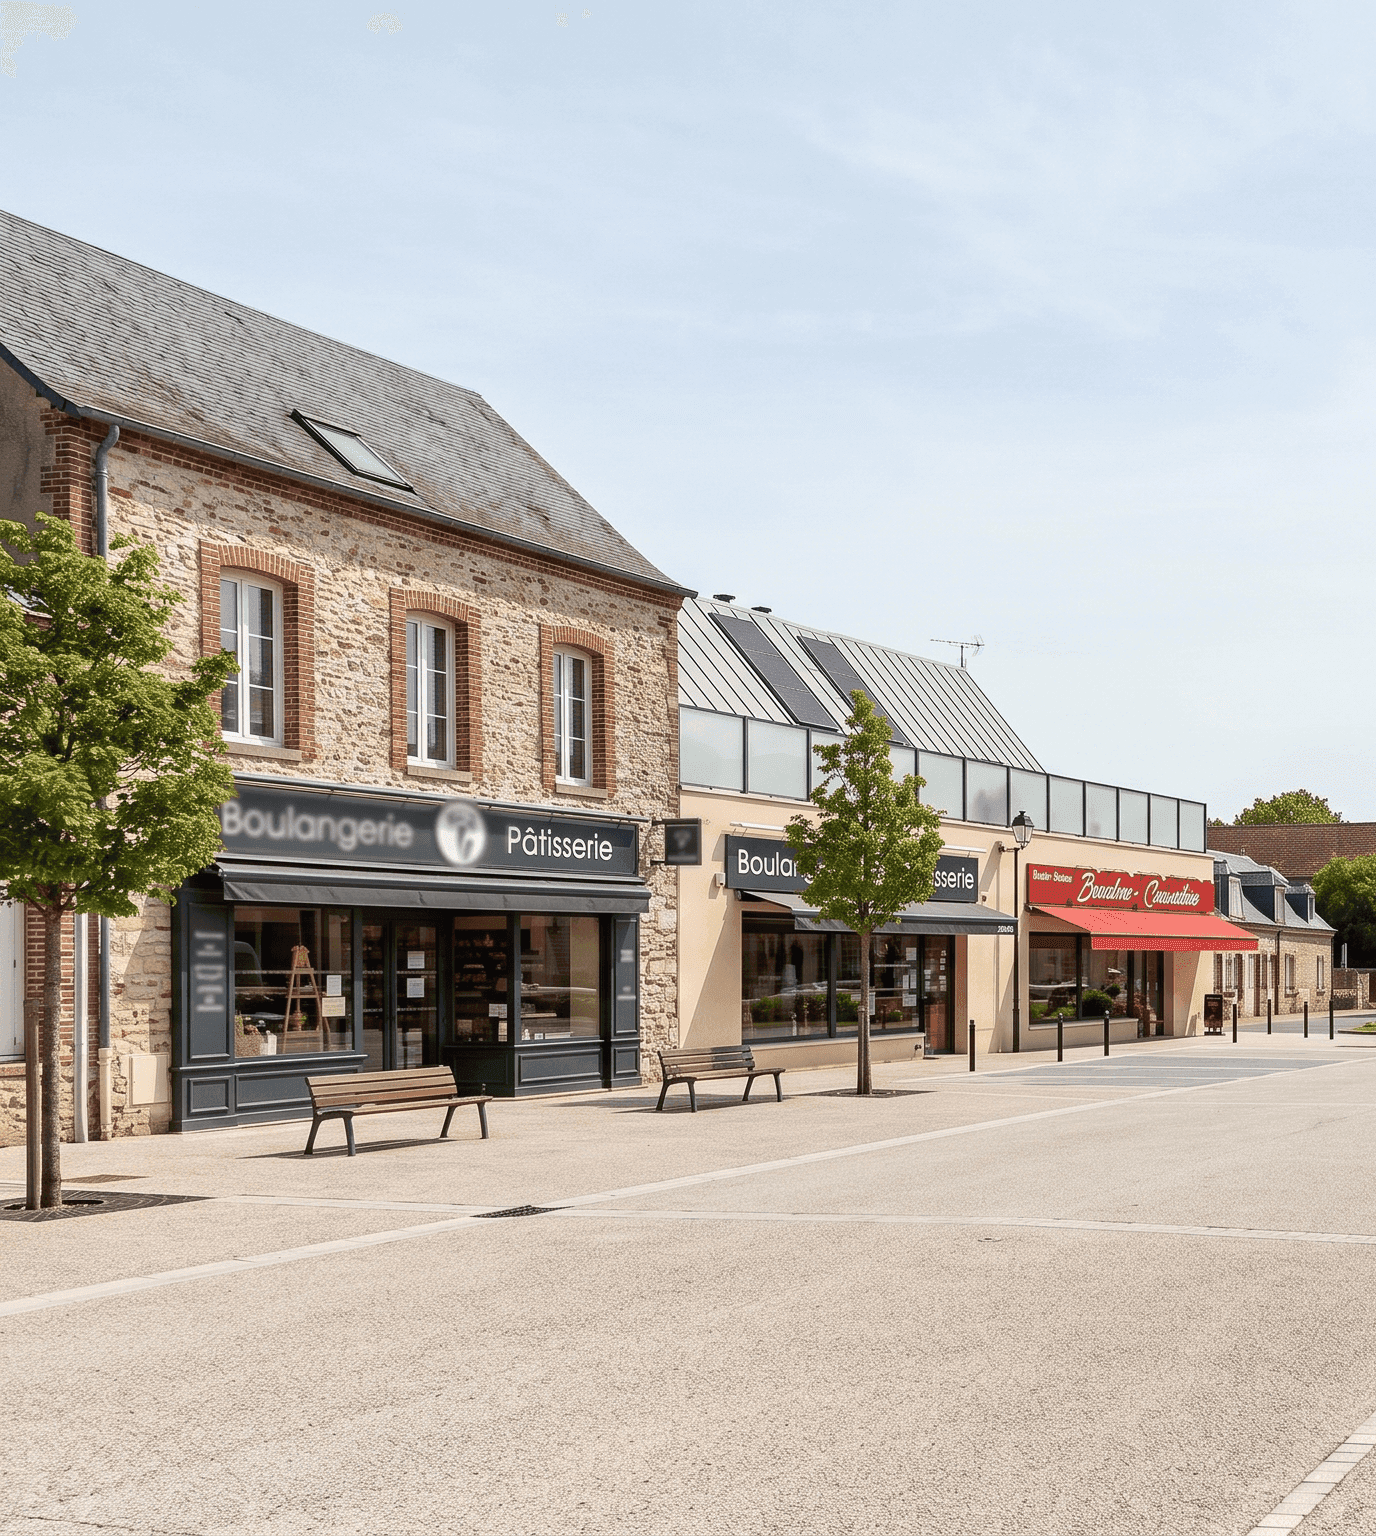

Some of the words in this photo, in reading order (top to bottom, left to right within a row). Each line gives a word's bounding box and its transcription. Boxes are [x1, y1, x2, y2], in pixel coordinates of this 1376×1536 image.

[222, 801, 414, 851] Boulangerie
[507, 825, 613, 861] Pâtisserie
[738, 848, 813, 884] Boula
[931, 866, 975, 889] sserie
